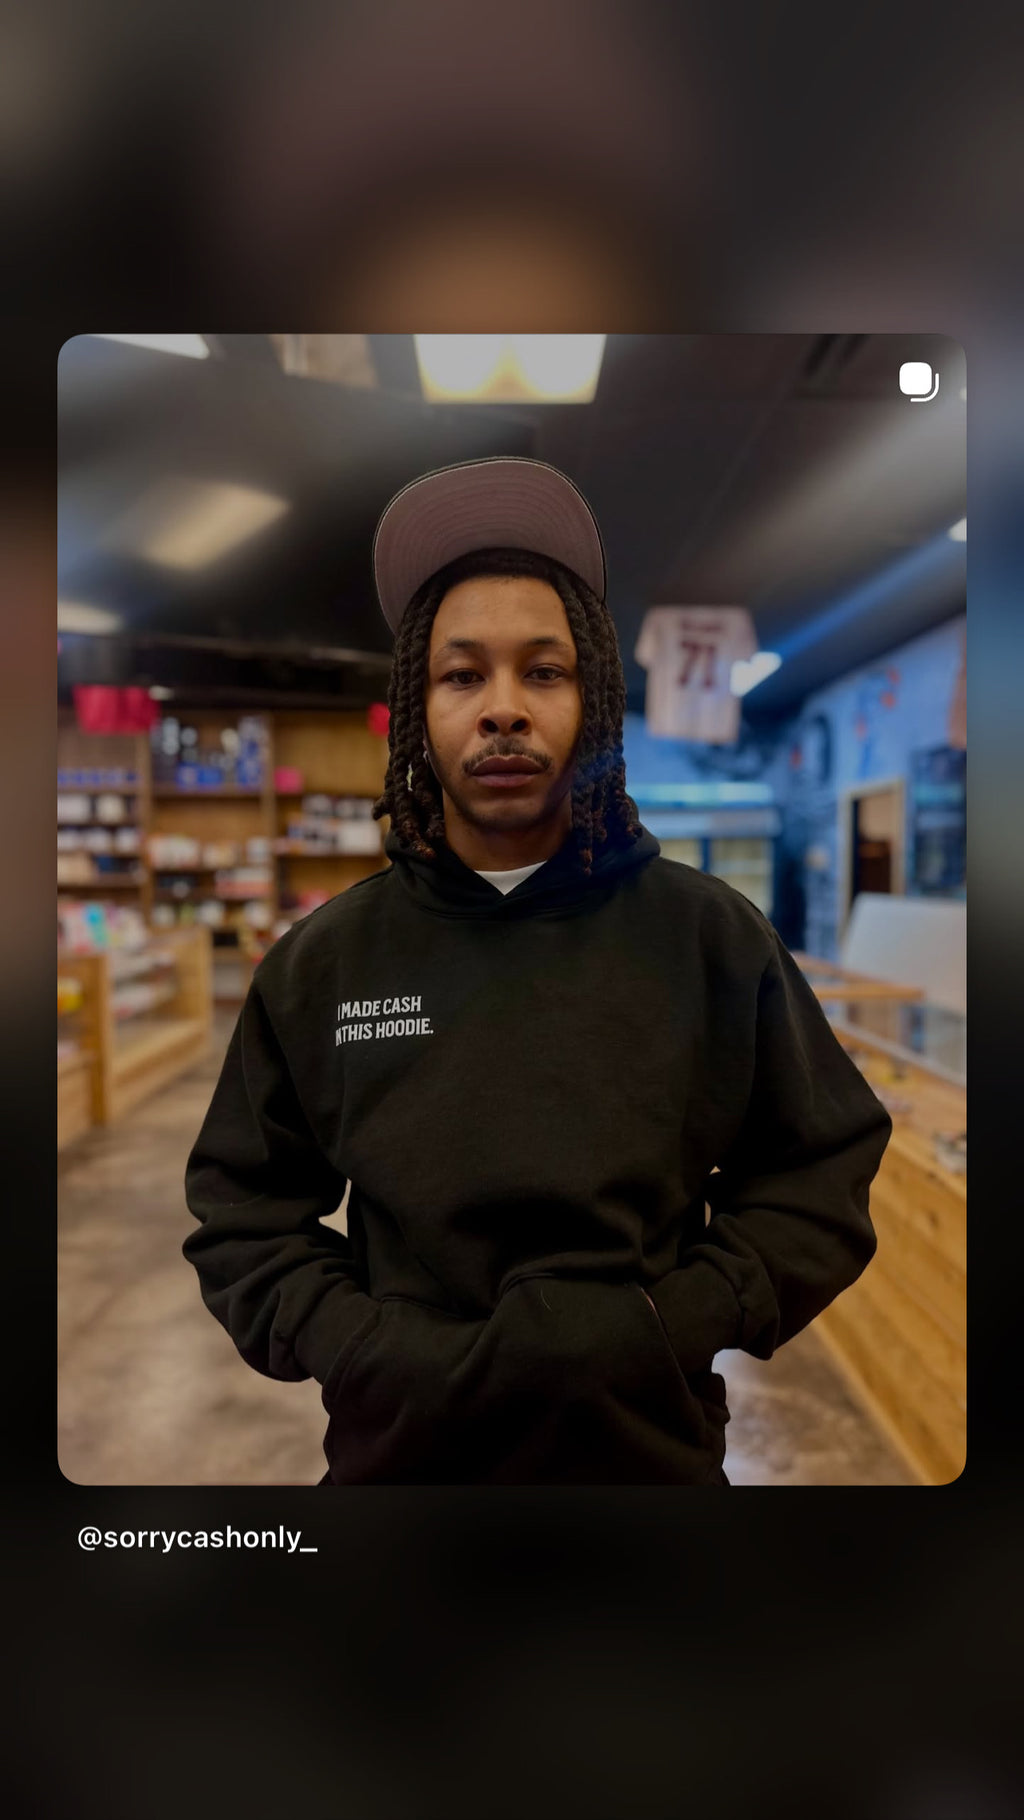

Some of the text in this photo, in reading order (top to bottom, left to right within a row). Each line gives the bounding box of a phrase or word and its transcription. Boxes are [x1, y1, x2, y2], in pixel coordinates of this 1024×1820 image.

[678, 640, 718, 688] 71
[341, 1000, 381, 1020] MADE
[383, 995, 422, 1015] CASH
[342, 1022, 373, 1043] THIS
[375, 1018, 434, 1039] HOODIE.
